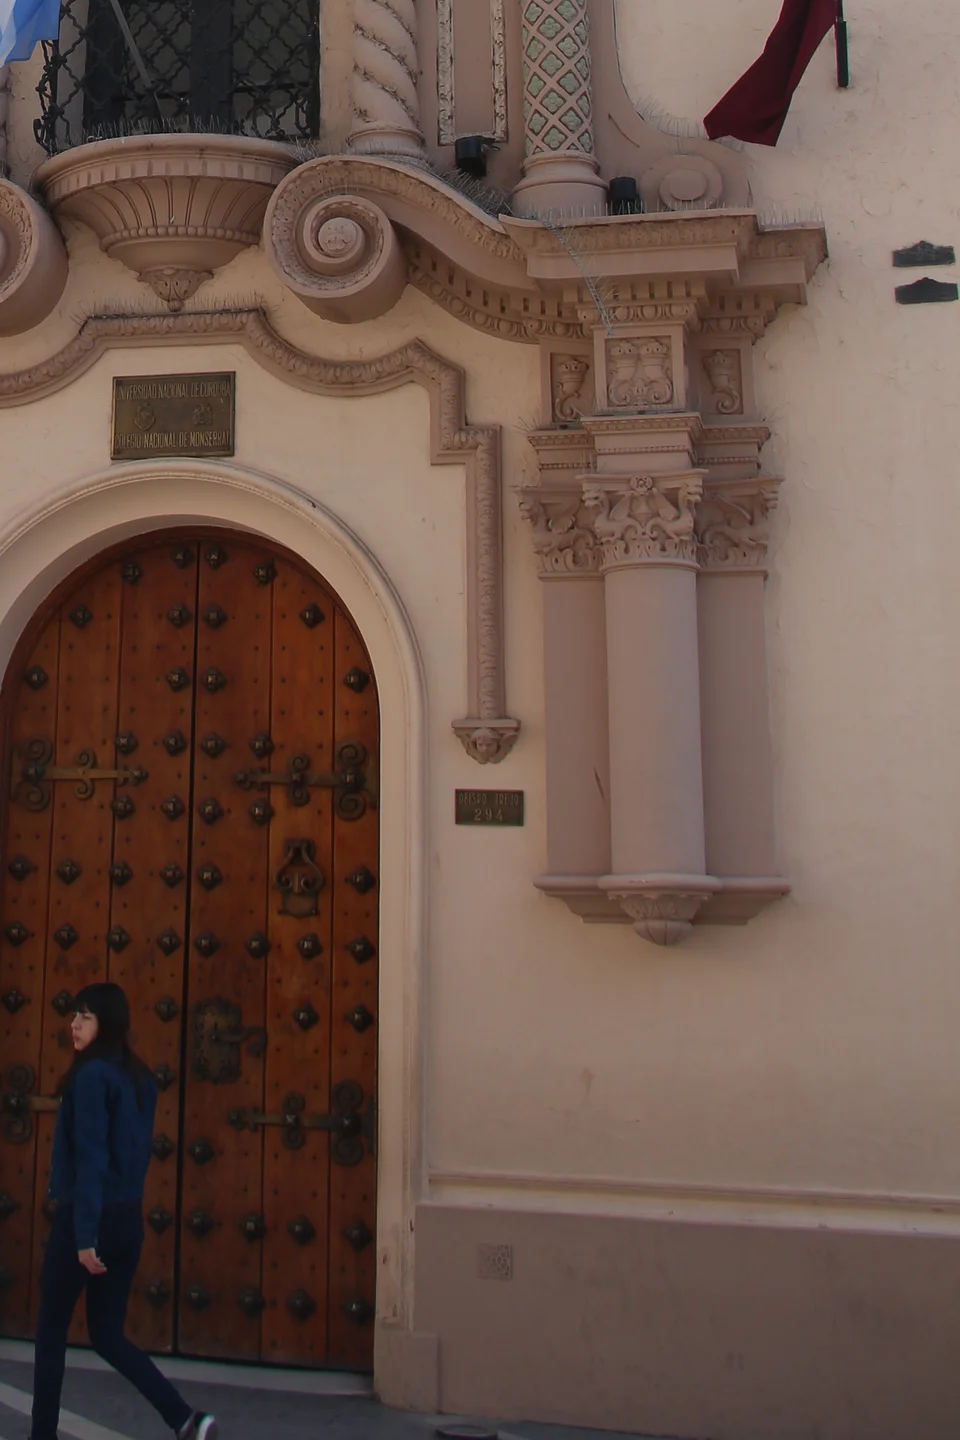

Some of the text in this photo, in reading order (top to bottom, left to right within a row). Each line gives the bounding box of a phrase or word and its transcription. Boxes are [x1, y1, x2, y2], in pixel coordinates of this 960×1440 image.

[158, 382, 189, 399] NACIONAL
[190, 382, 199, 398] DE
[114, 430, 230, 449] COLEGIO NACIONAL DE MONSERRAT
[474, 808, 503, 822] 294
